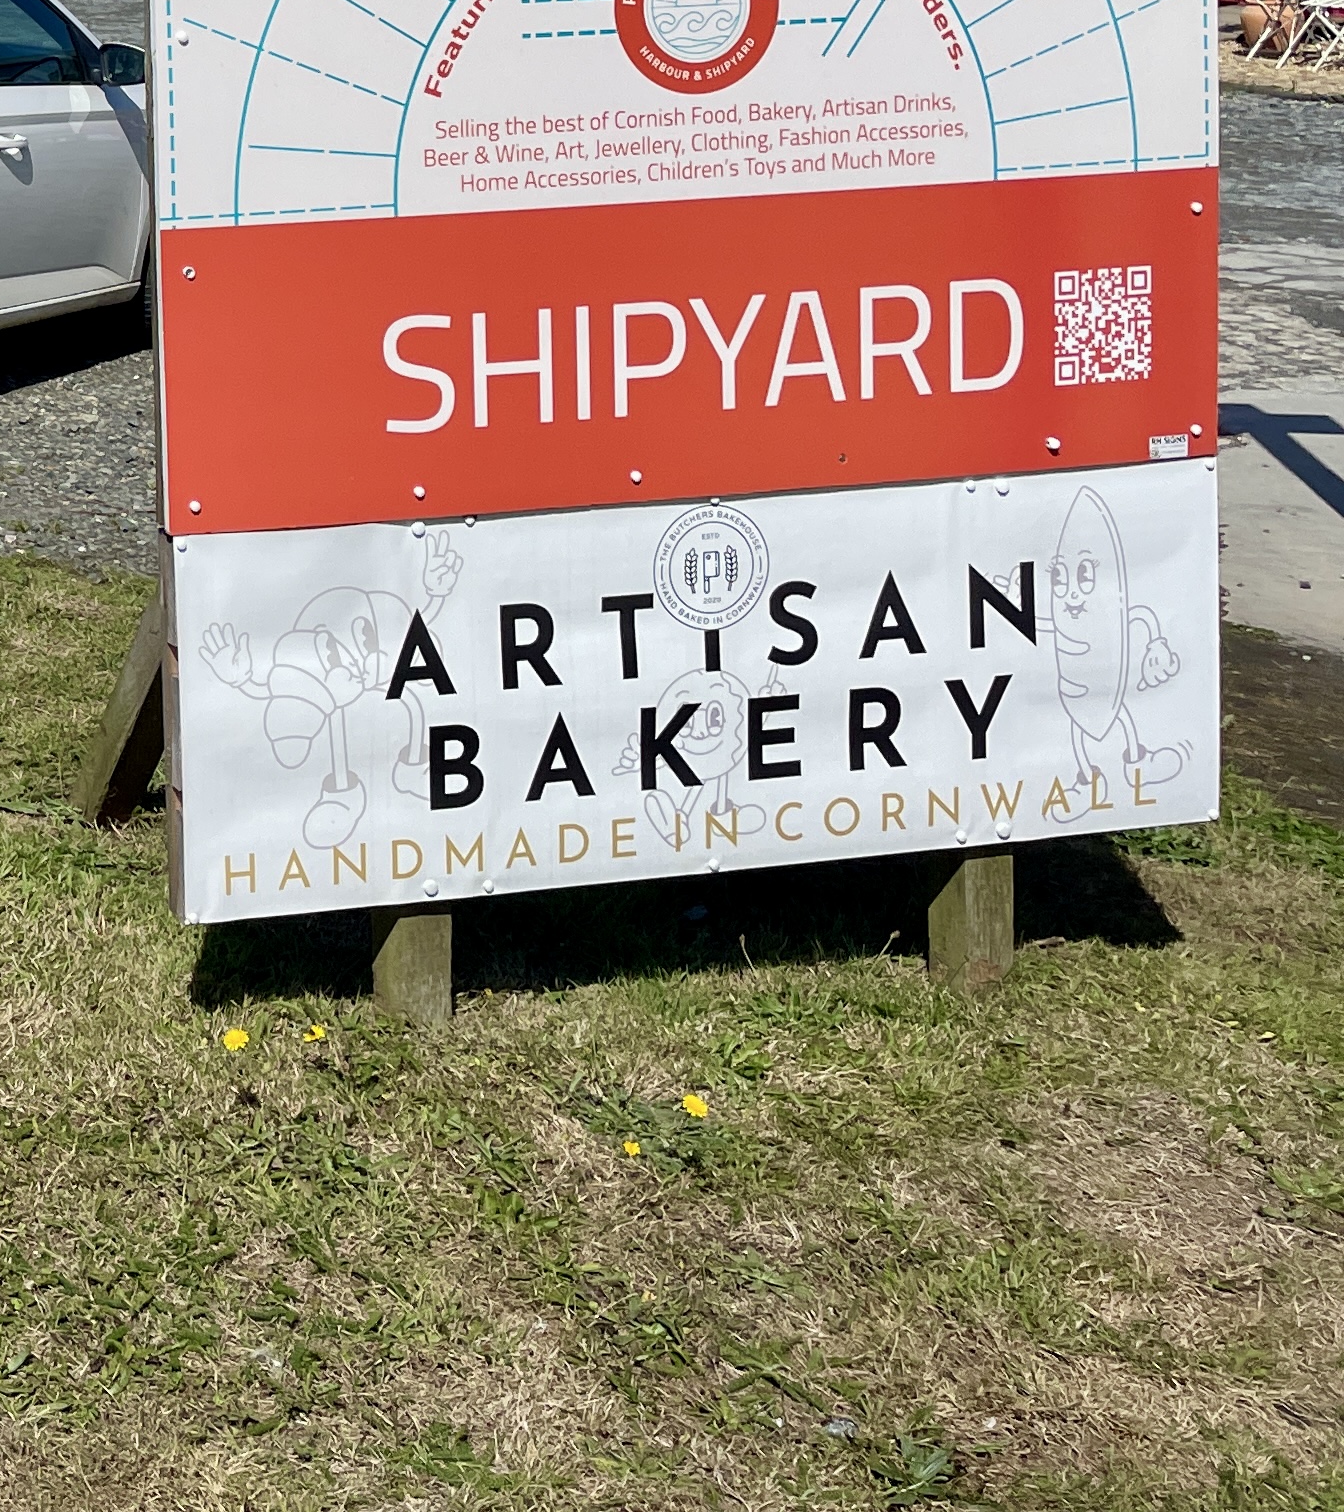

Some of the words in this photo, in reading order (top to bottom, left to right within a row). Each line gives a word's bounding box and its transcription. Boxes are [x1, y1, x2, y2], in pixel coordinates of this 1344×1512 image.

[639, 45, 690, 81] HARBOUR
[693, 70, 703, 81] &
[705, 37, 756, 80] SHIPYARD
[435, 119, 500, 142] Selling
[505, 116, 537, 136] the
[543, 114, 585, 134] best
[590, 111, 610, 131] of
[614, 107, 686, 129] Cornish
[691, 104, 742, 125] Food,
[748, 101, 817, 124] Bakery,
[822, 97, 888, 117] Artisan
[893, 92, 957, 114] Drinks,
[424, 148, 470, 167] Beer
[474, 146, 490, 164] &
[495, 143, 550, 164] Wine,
[555, 141, 590, 162] Art,
[594, 135, 686, 159] Jewellery,
[691, 130, 773, 154] Clothing,
[779, 125, 851, 147] Fashion
[856, 119, 969, 143] Accessories,
[461, 174, 519, 193] Home
[524, 165, 642, 189] Accessories,
[647, 158, 740, 182] Children's
[744, 156, 787, 179] Toys
[791, 152, 826, 173] and
[831, 149, 882, 171] Much
[888, 148, 936, 167] More
[381, 277, 1025, 435] SHIPYARD
[660, 543, 671, 562] THE
[669, 510, 714, 541] BUTCHERS
[716, 510, 763, 551] BAKEHOUSE
[660, 582, 678, 610] HAND
[677, 608, 710, 625] BAKED
[712, 615, 724, 625] IN
[725, 574, 764, 621] CORNWALL
[384, 560, 1038, 701] ARTISAN
[429, 673, 1014, 811] BAKERY
[224, 817, 638, 897] HANDMADE
[674, 806, 740, 849] IN
[774, 767, 1160, 843] CORNWALL
